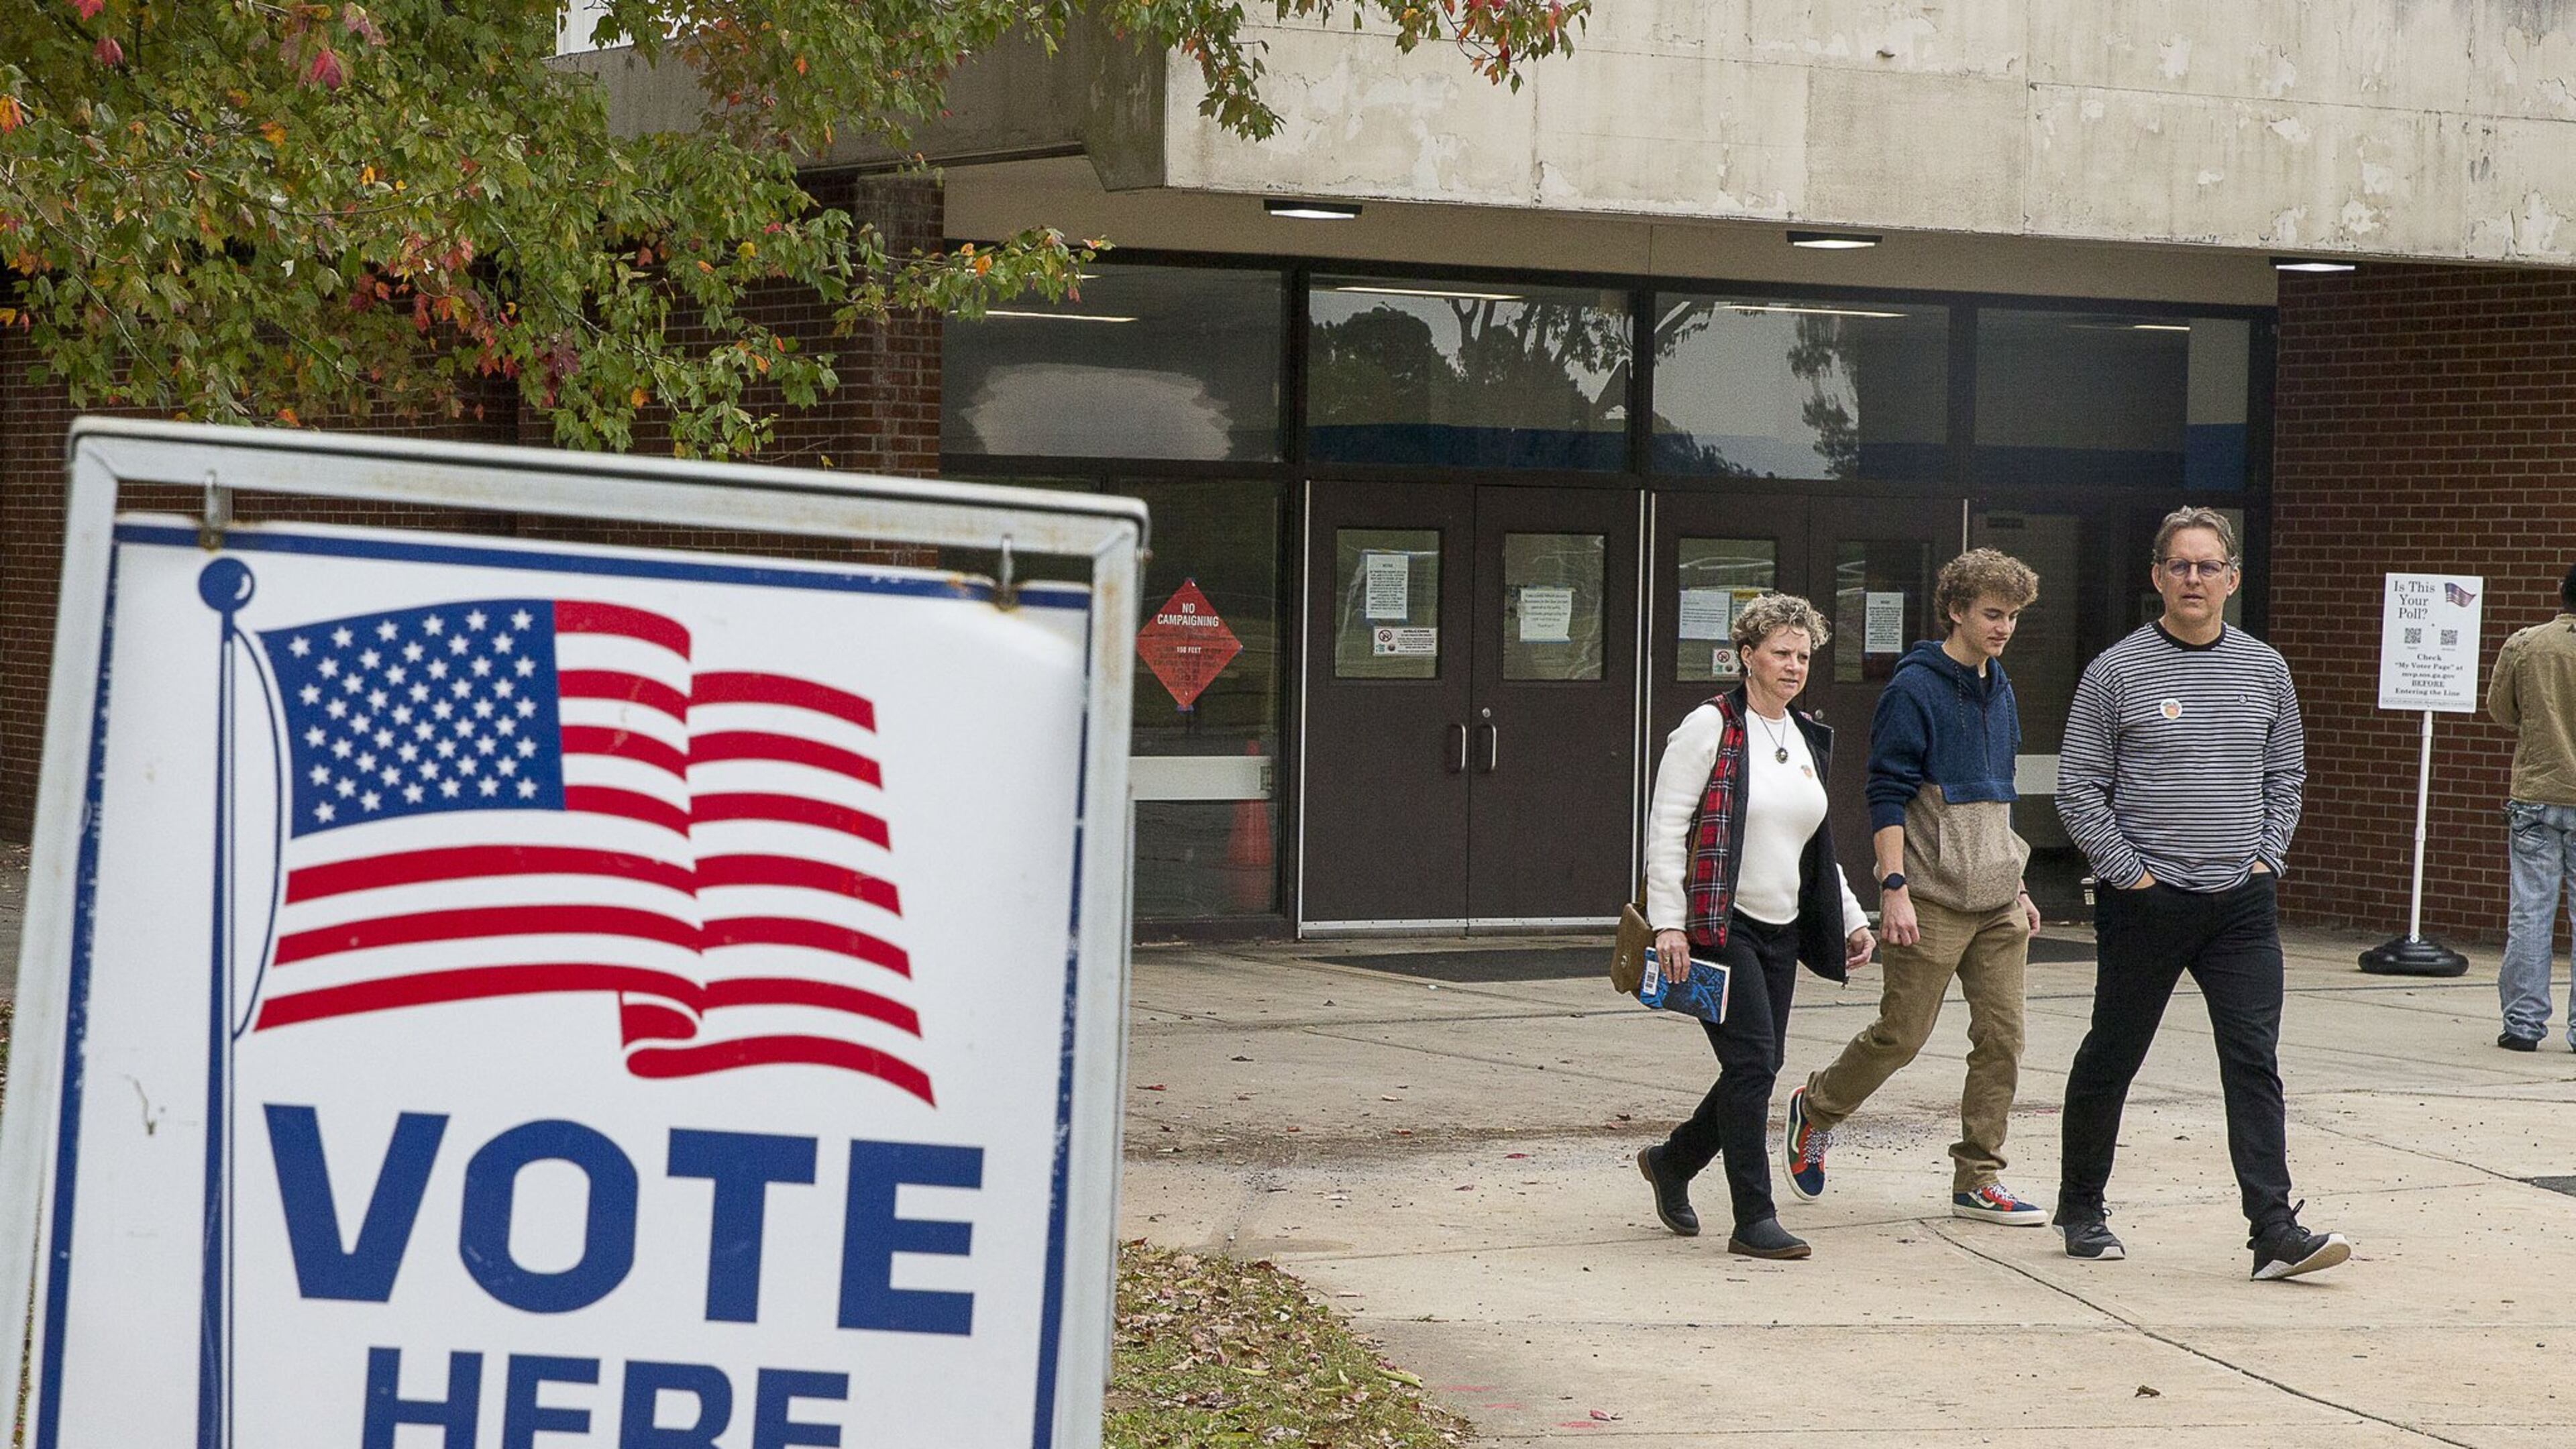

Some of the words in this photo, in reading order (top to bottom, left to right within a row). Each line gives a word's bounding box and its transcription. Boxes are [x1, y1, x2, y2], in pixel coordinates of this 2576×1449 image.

[2394, 580, 2405, 592] Is
[2408, 580, 2436, 593] This
[2399, 594, 2429, 606] Your
[1182, 603, 1195, 614] NO
[2398, 607, 2428, 620] Poll?
[1157, 614, 1219, 627] CAMPAIGNING
[1188, 646, 1202, 654] FEET
[2395, 688, 2428, 696] Entering
[264, 1104, 983, 1336] VOTE
[362, 1347, 849, 1449] HERE
